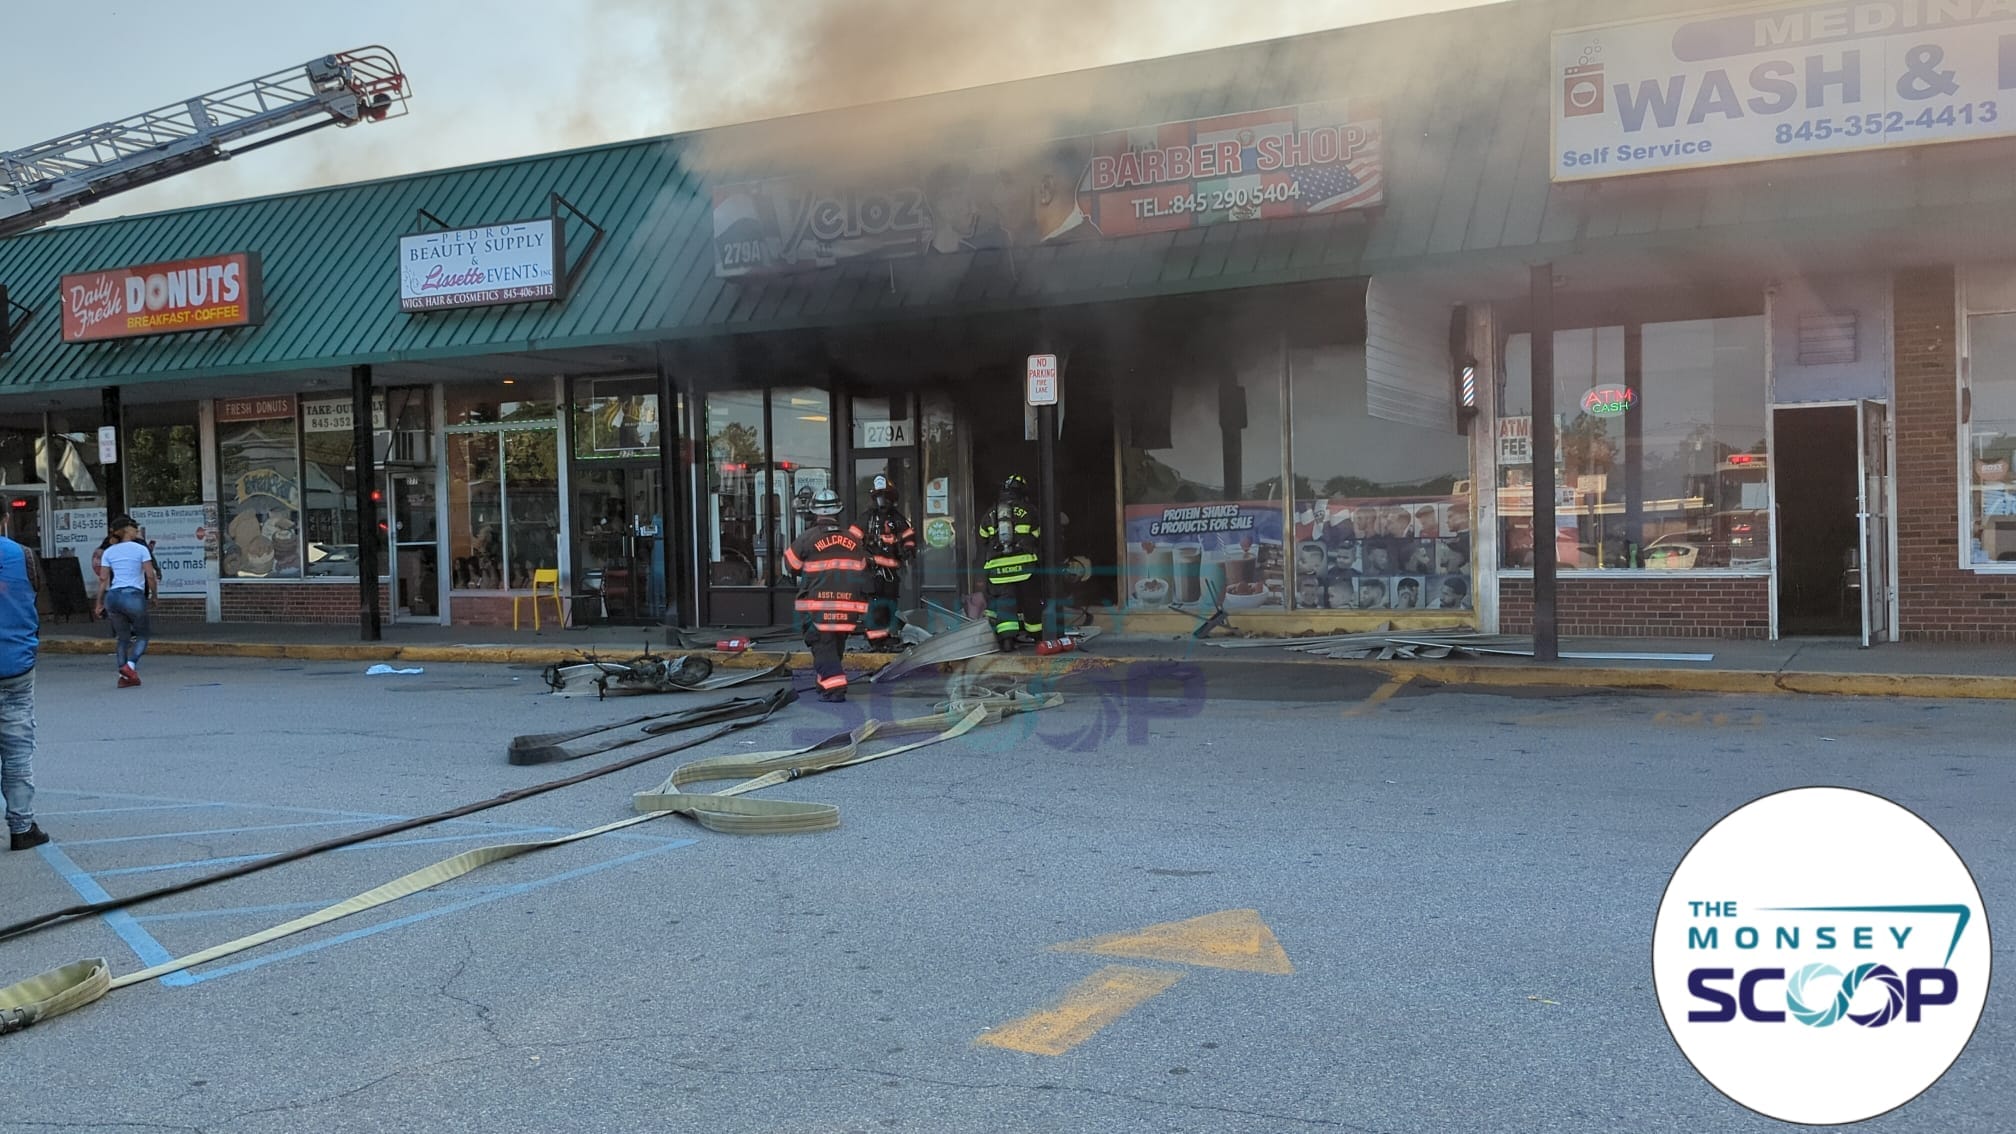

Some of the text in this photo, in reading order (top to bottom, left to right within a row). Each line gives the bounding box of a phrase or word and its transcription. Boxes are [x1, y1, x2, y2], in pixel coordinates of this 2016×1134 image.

[1614, 50, 1861, 133] WASH
[1896, 44, 1960, 100] &
[1775, 101, 1997, 144] 845-352-4413
[1092, 126, 1366, 190] BARBER SHOP
[1562, 138, 1712, 168] Self Service
[1211, 188, 1247, 209] 290
[1252, 181, 1301, 205] 5404
[762, 181, 926, 262] Veloz
[442, 226, 510, 242] PEDRO
[410, 233, 544, 262] BEAUTY SUPPLY
[723, 241, 761, 265] 279A
[471, 256, 479, 266] &
[421, 264, 485, 290] Lissette
[487, 264, 539, 283] EVENTS
[70, 262, 240, 314] Daily DONUTS
[425, 296, 445, 307] HAIR
[446, 295, 452, 304] &
[454, 291, 499, 304] COSMETICS
[503, 285, 553, 299] 845-406-3113
[74, 288, 122, 337] Fresh
[1036, 358, 1047, 367] NO
[1029, 369, 1055, 377] PARKING
[1585, 388, 1633, 408] ATM
[1592, 402, 1630, 413] CASH
[225, 400, 288, 416] FRESH DONUTS
[868, 424, 905, 442] 279A
[1501, 419, 1528, 437] ATM
[1501, 438, 1526, 455] FEE
[1163, 504, 1239, 521] PROTEIN SHAKES
[1151, 516, 1253, 534] & PRODUCTS FOR SALE
[814, 535, 857, 552] HILLCREST
[183, 558, 207, 570] mas!
